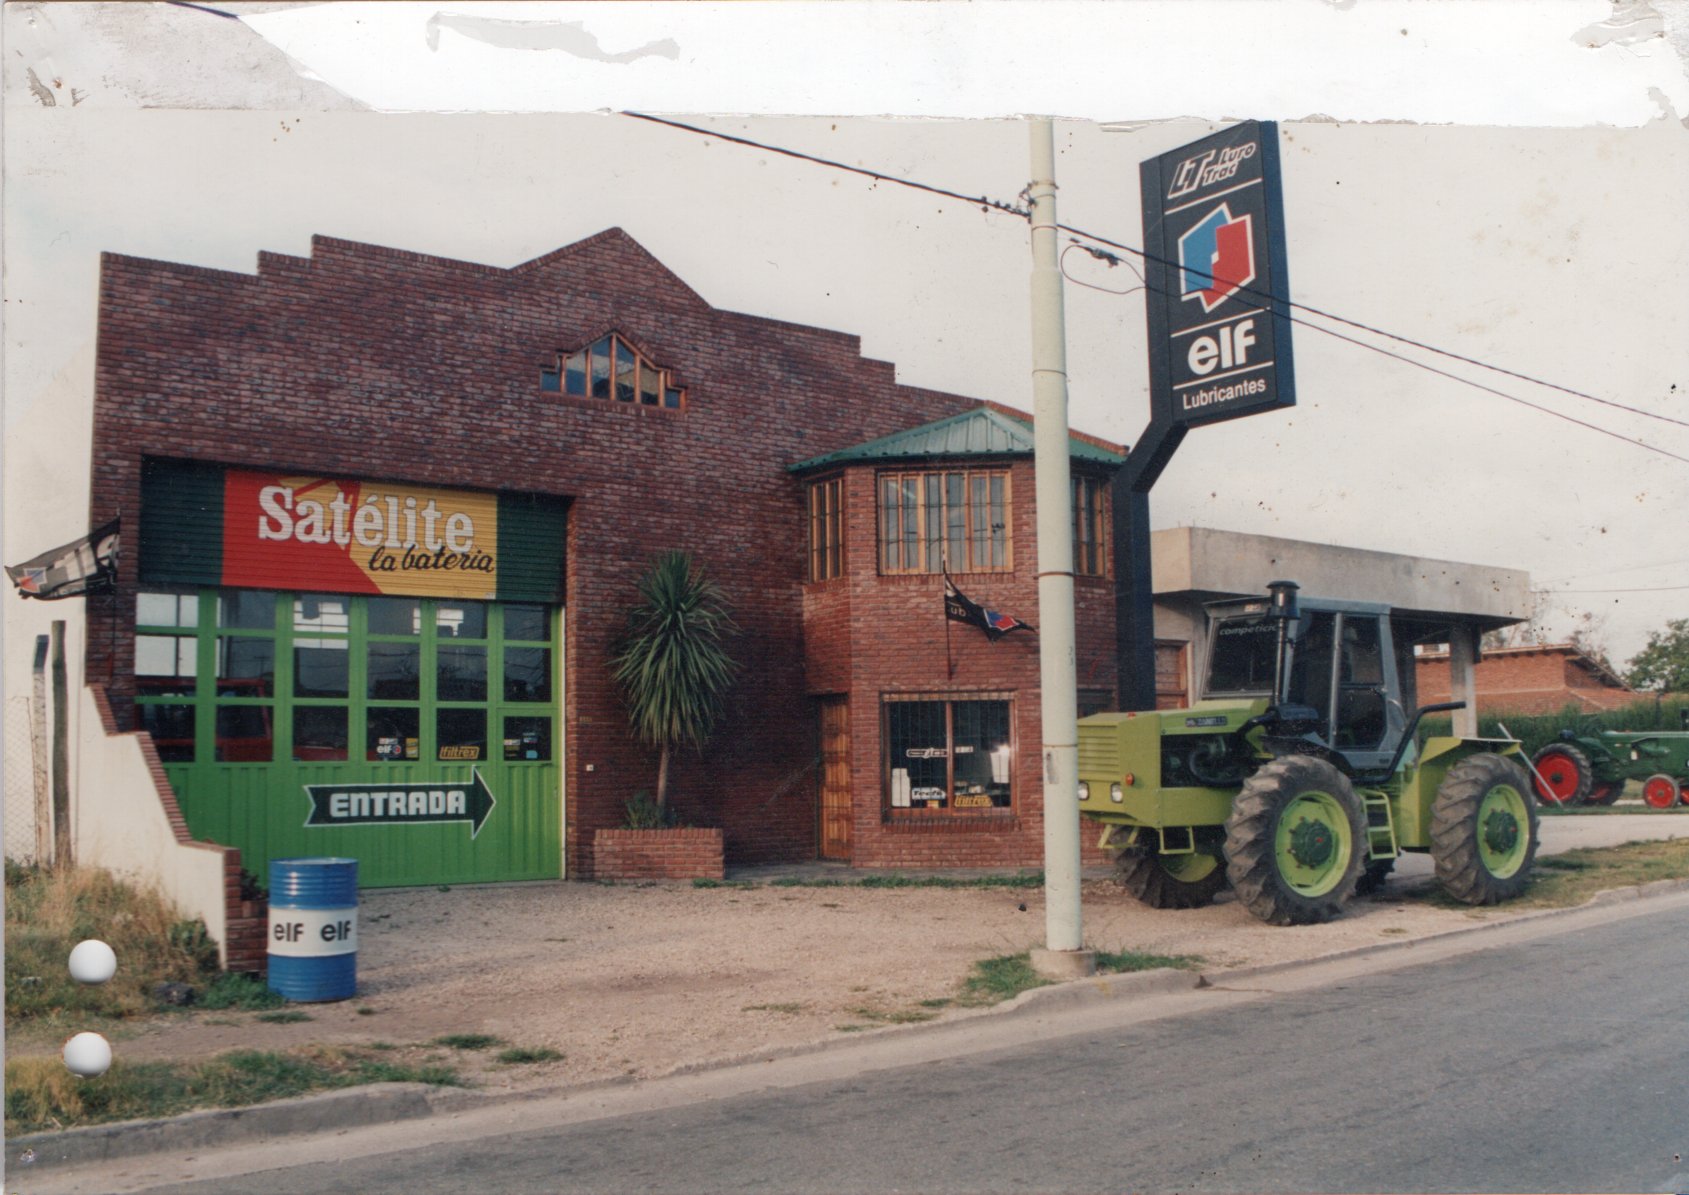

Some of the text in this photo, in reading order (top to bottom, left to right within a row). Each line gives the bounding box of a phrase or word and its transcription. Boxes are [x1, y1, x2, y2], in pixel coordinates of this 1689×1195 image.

[1218, 141, 1257, 168] Luro
[1202, 162, 1239, 187] Trac
[1187, 318, 1256, 377] elf
[1182, 376, 1267, 411] Lubricantes
[258, 485, 475, 554] Satélite
[368, 546, 396, 572] la
[376, 745, 392, 754] elf
[329, 790, 466, 818] ENTRADA
[274, 920, 352, 943] elf elf
